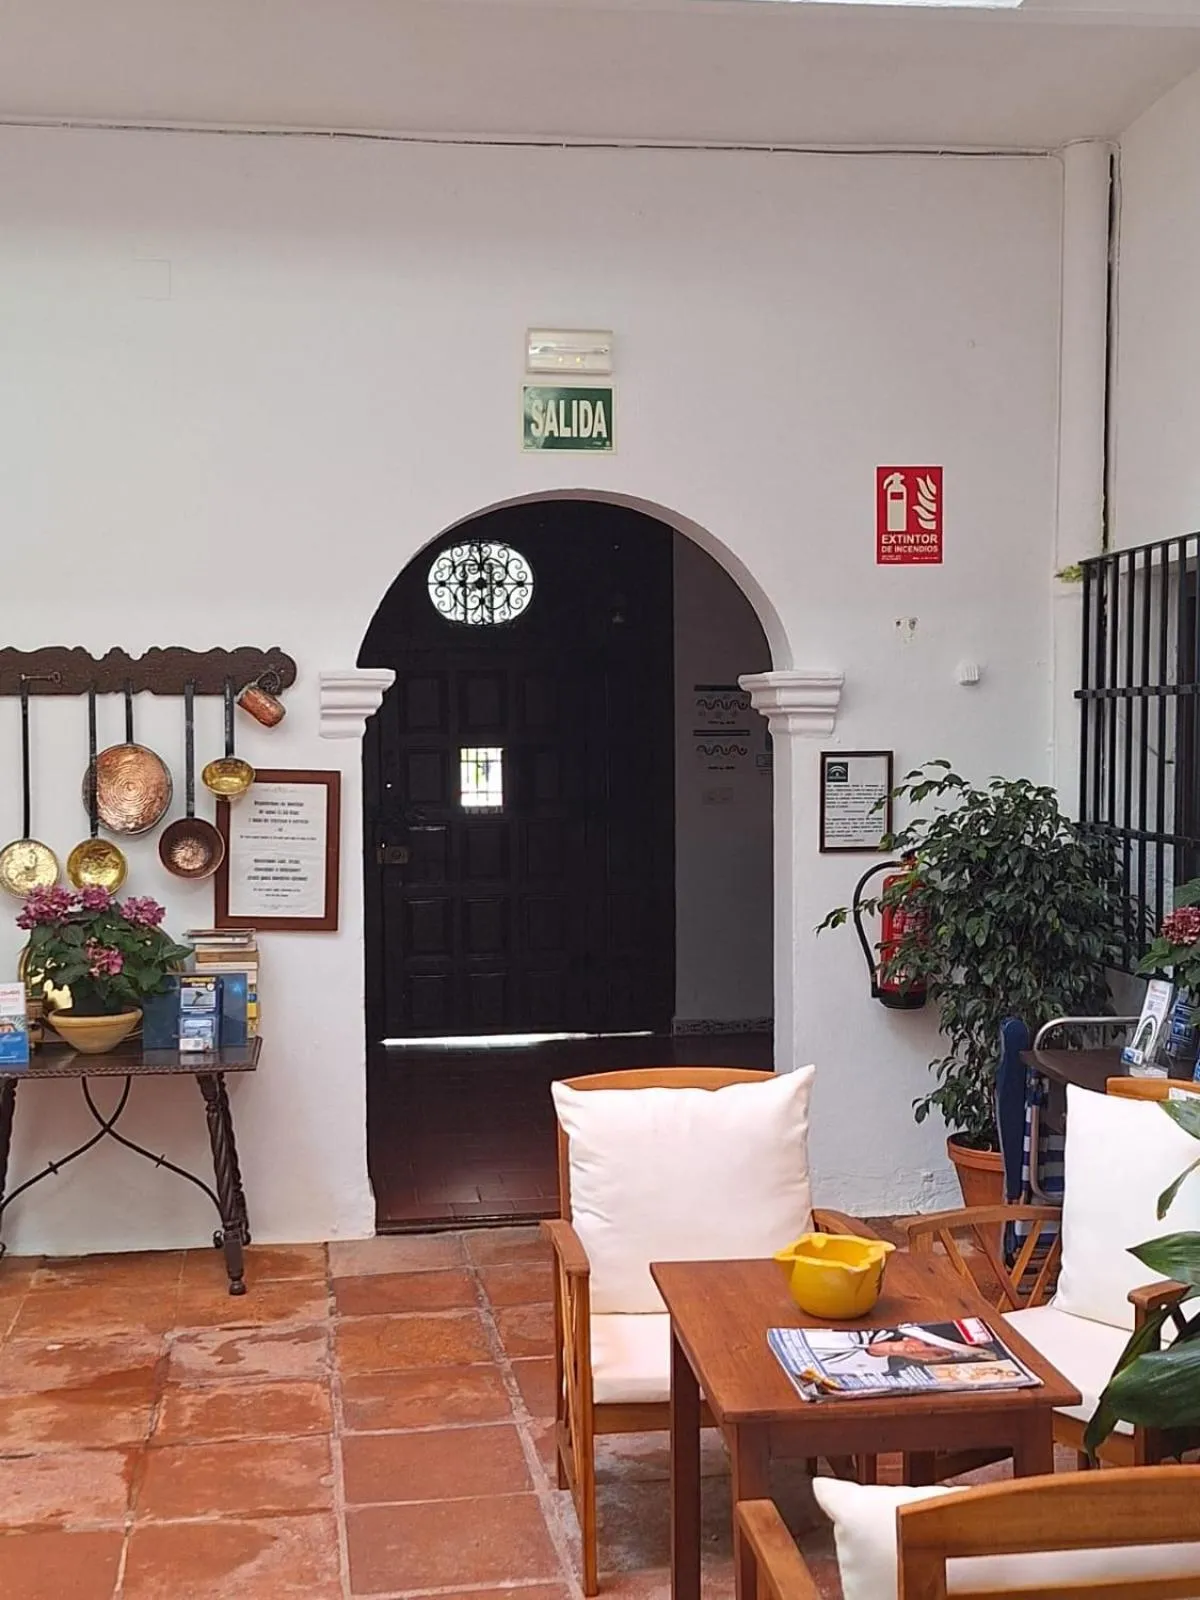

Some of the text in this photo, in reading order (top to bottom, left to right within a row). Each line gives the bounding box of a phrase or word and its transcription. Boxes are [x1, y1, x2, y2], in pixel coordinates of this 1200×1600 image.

[531, 400, 607, 438] SALIDA
[881, 534, 938, 544] EXTINTOR
[881, 545, 939, 553] DE INCENDIOS
